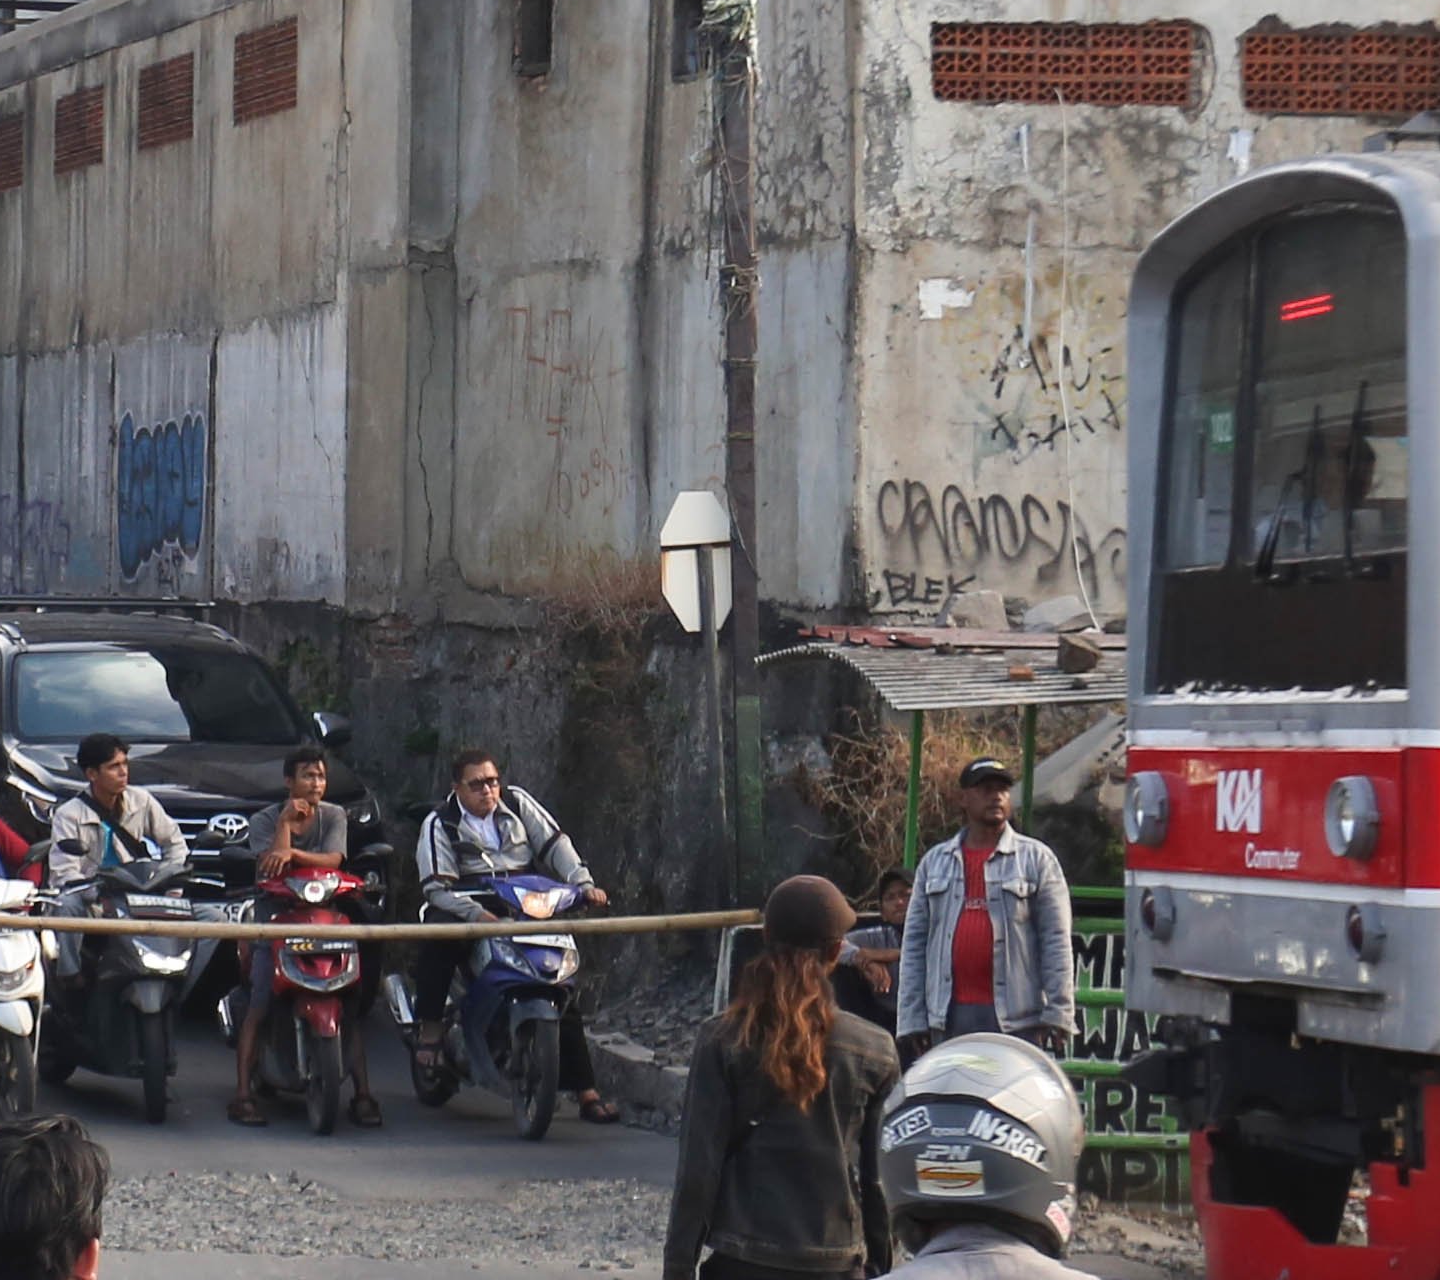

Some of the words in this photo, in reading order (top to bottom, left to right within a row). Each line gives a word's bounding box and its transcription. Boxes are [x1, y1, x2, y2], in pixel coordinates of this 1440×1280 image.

[1216, 768, 1262, 834] KAI
[1245, 842, 1300, 870] Commuter
[917, 1144, 971, 1161] JPN
